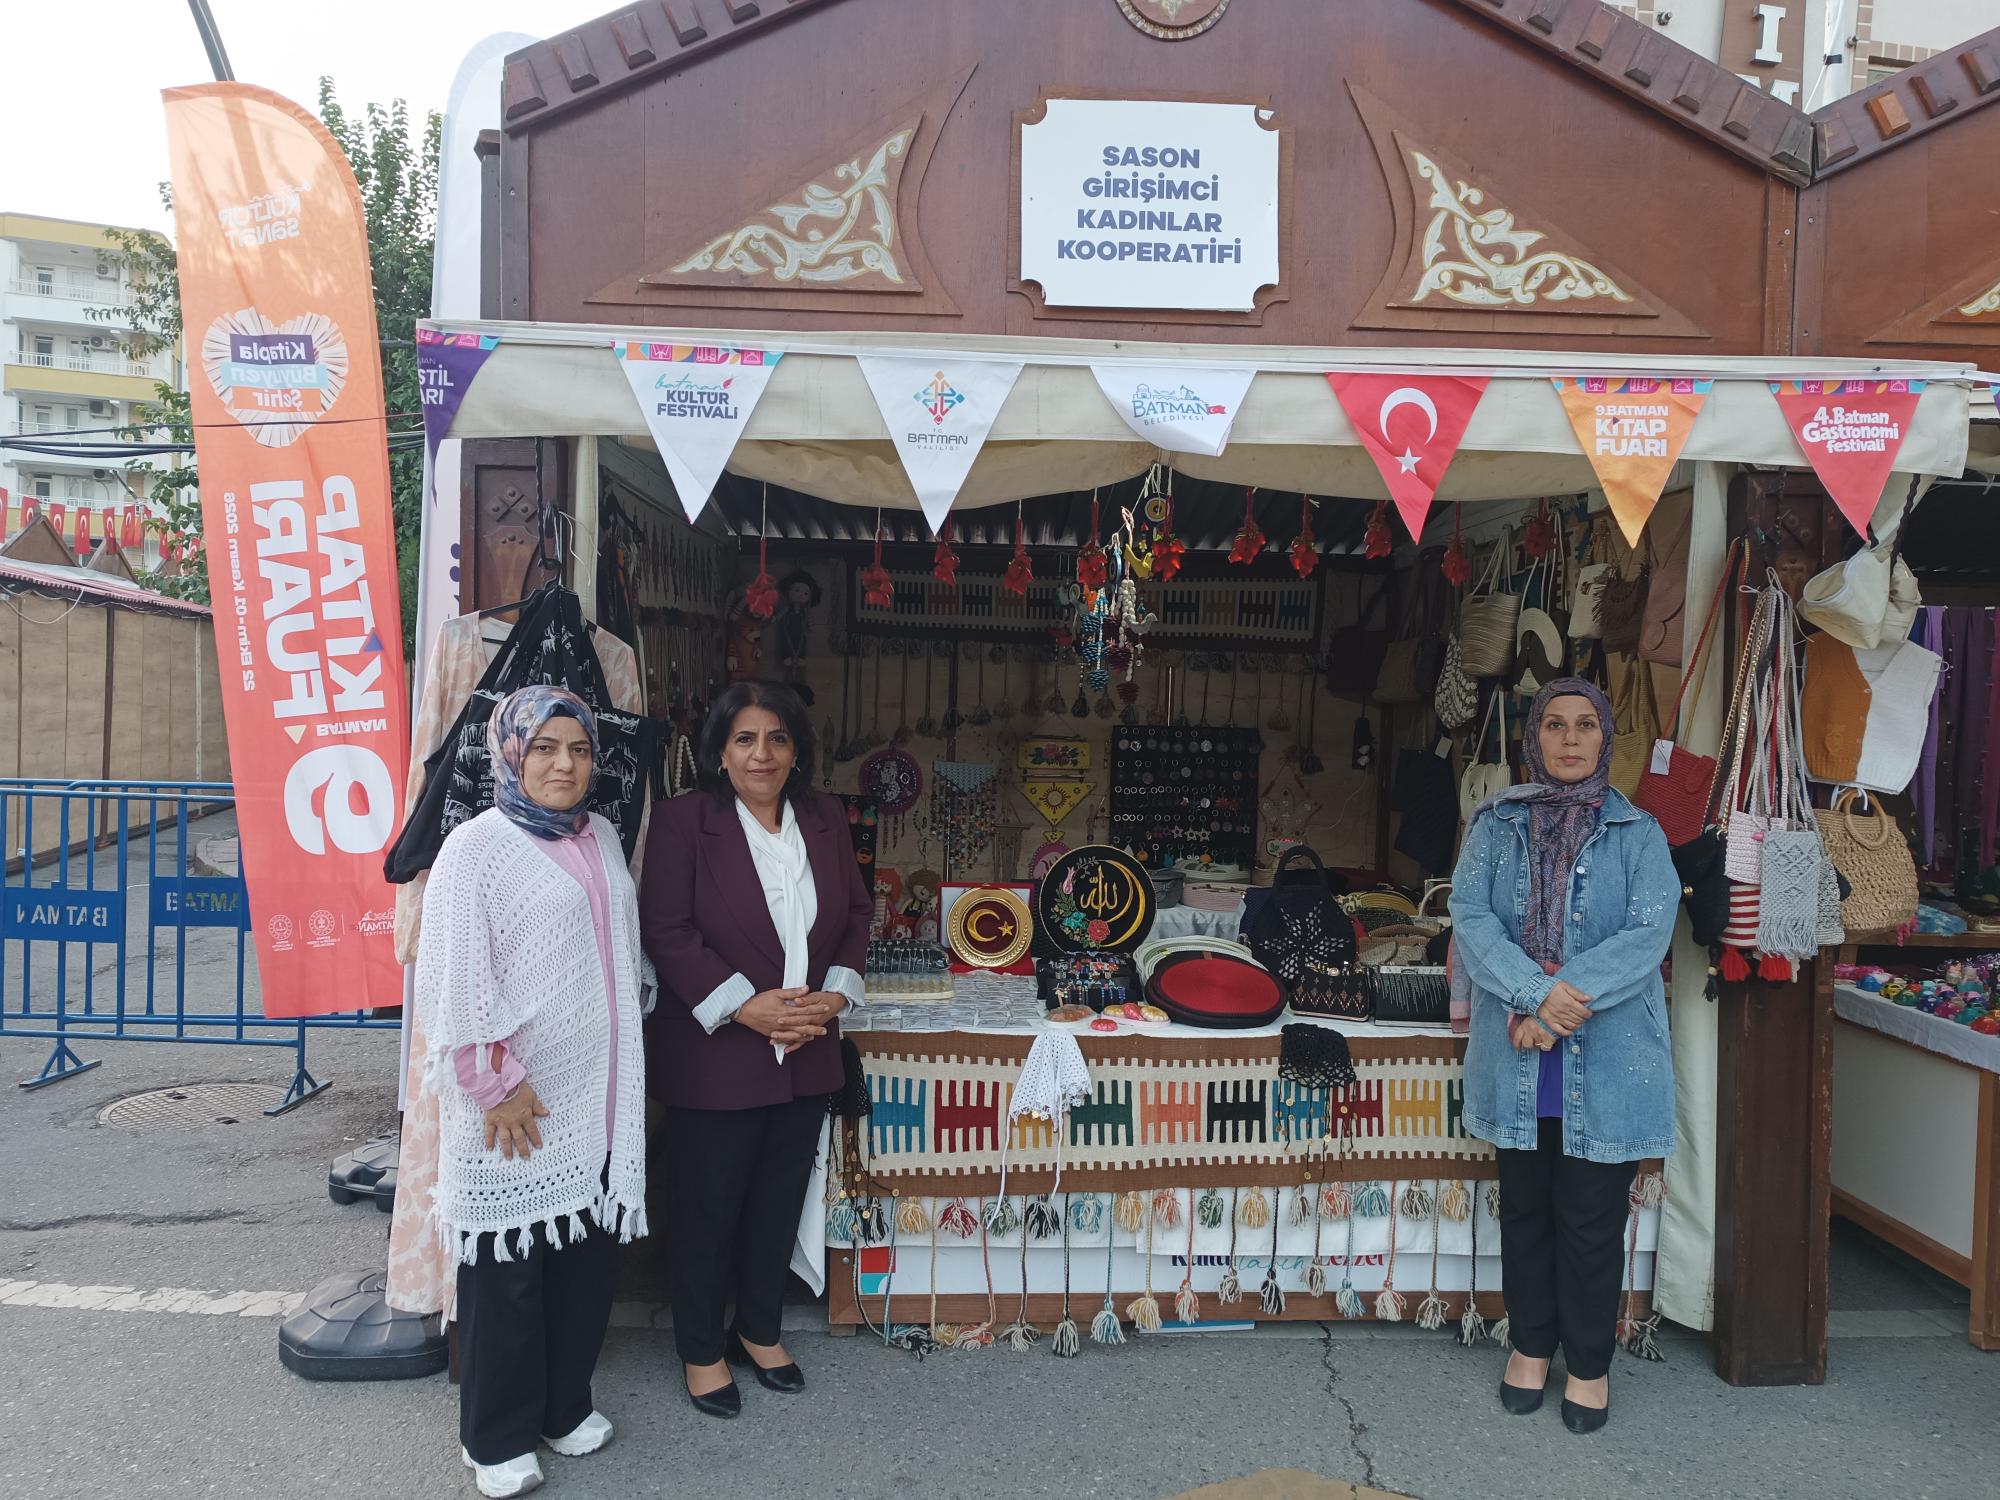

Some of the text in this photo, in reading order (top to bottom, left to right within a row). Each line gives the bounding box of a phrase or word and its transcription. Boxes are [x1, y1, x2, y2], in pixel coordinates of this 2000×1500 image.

[1103, 146, 1200, 168] SASON
[1083, 171, 1219, 203] GİRİŞİMCİ
[1077, 209, 1222, 232] KADINLAR
[1057, 237, 1242, 264] KOOPERATİFİ
[666, 390, 729, 405] KÜLTÜR
[1132, 400, 1210, 418] BATMAN
[907, 433, 968, 445] BATMAN
[1802, 422, 1900, 442] Gastronomi
[1596, 438, 1667, 457] FUARI
[1826, 438, 1886, 453] festivali
